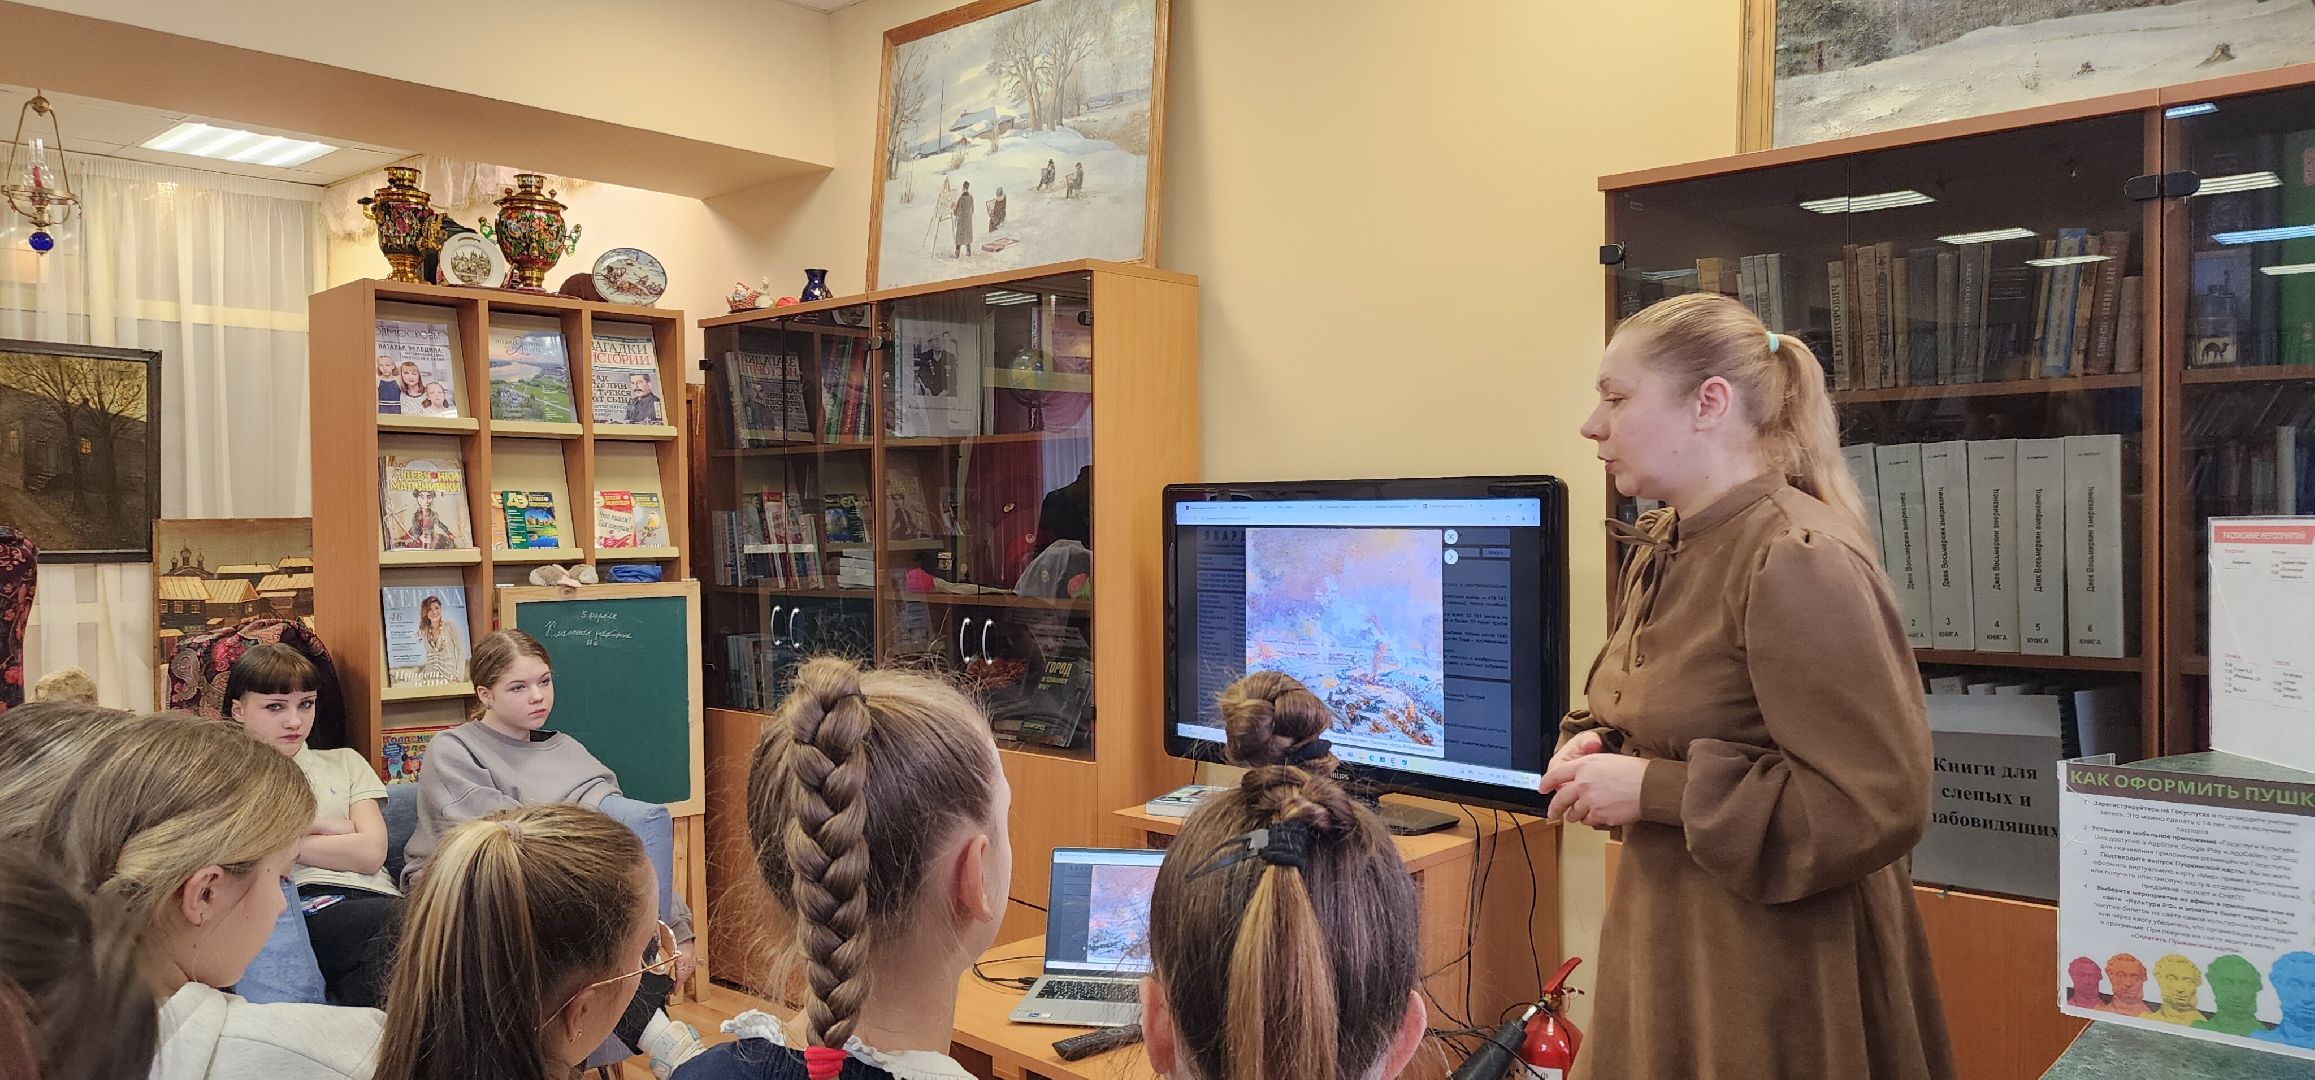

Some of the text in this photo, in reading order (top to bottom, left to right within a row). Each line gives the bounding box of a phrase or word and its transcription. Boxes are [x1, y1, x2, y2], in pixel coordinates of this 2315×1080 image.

[1912, 619, 1916, 627] 2
[1946, 618, 1951, 626] 3
[1045, 661, 1073, 677] ГОРОД
[1934, 756, 2038, 780] Книги для
[2070, 770, 2111, 787] КАК
[2113, 775, 2239, 800] ОФОРМИТЬ
[1942, 786, 2031, 808] слепых и
